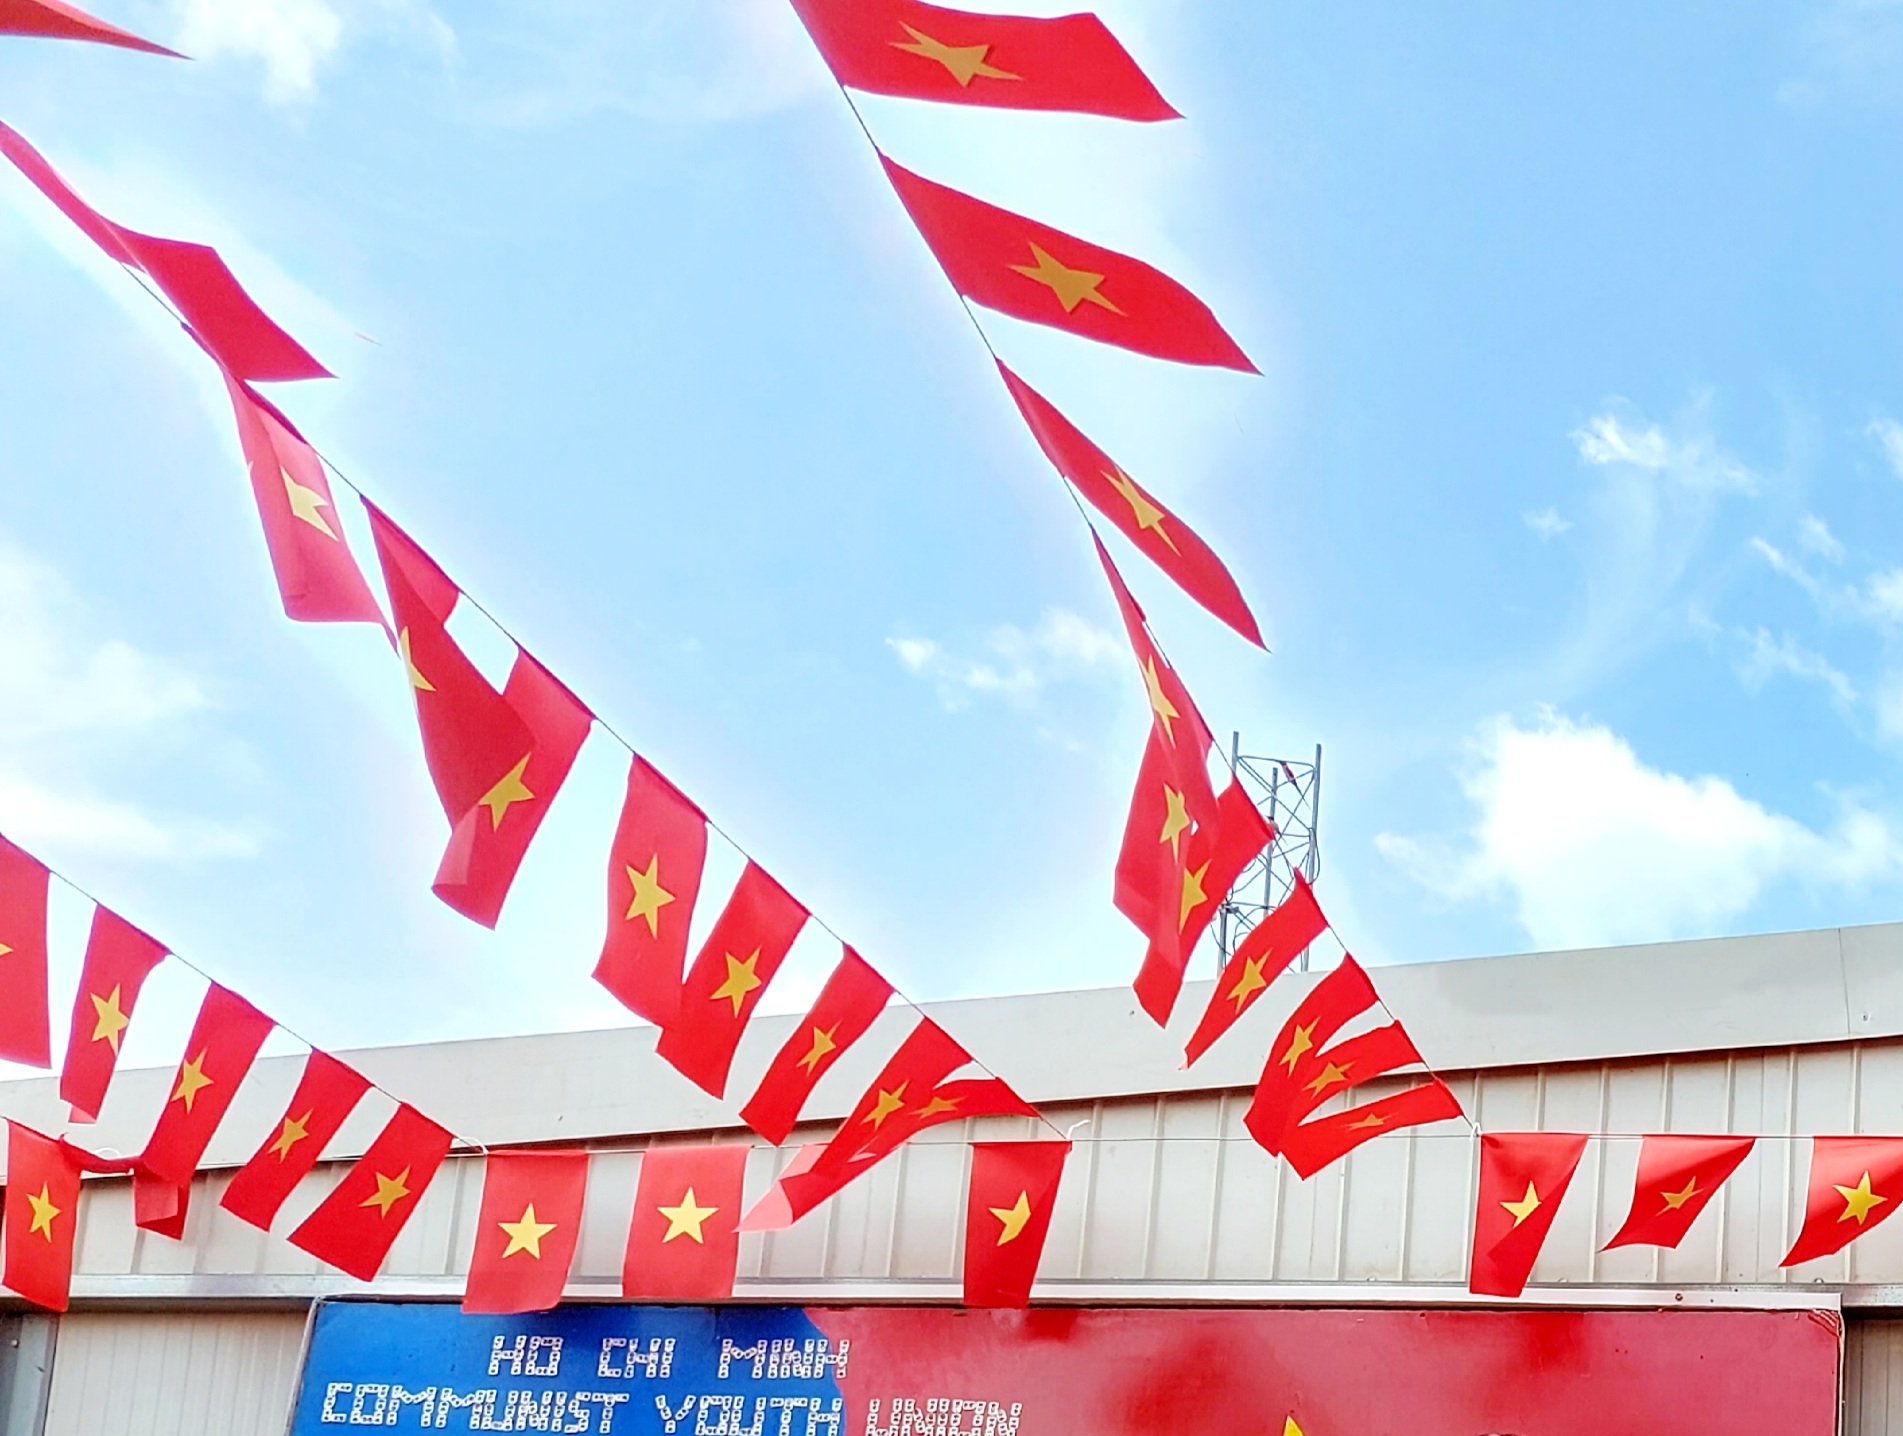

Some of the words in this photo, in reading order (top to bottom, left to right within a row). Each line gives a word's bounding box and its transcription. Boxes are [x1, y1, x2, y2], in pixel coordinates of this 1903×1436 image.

[488, 1335, 563, 1375] HO
[598, 1337, 675, 1378] CHI
[718, 1339, 849, 1379] MINH
[321, 1382, 629, 1433] COMMUNIST
